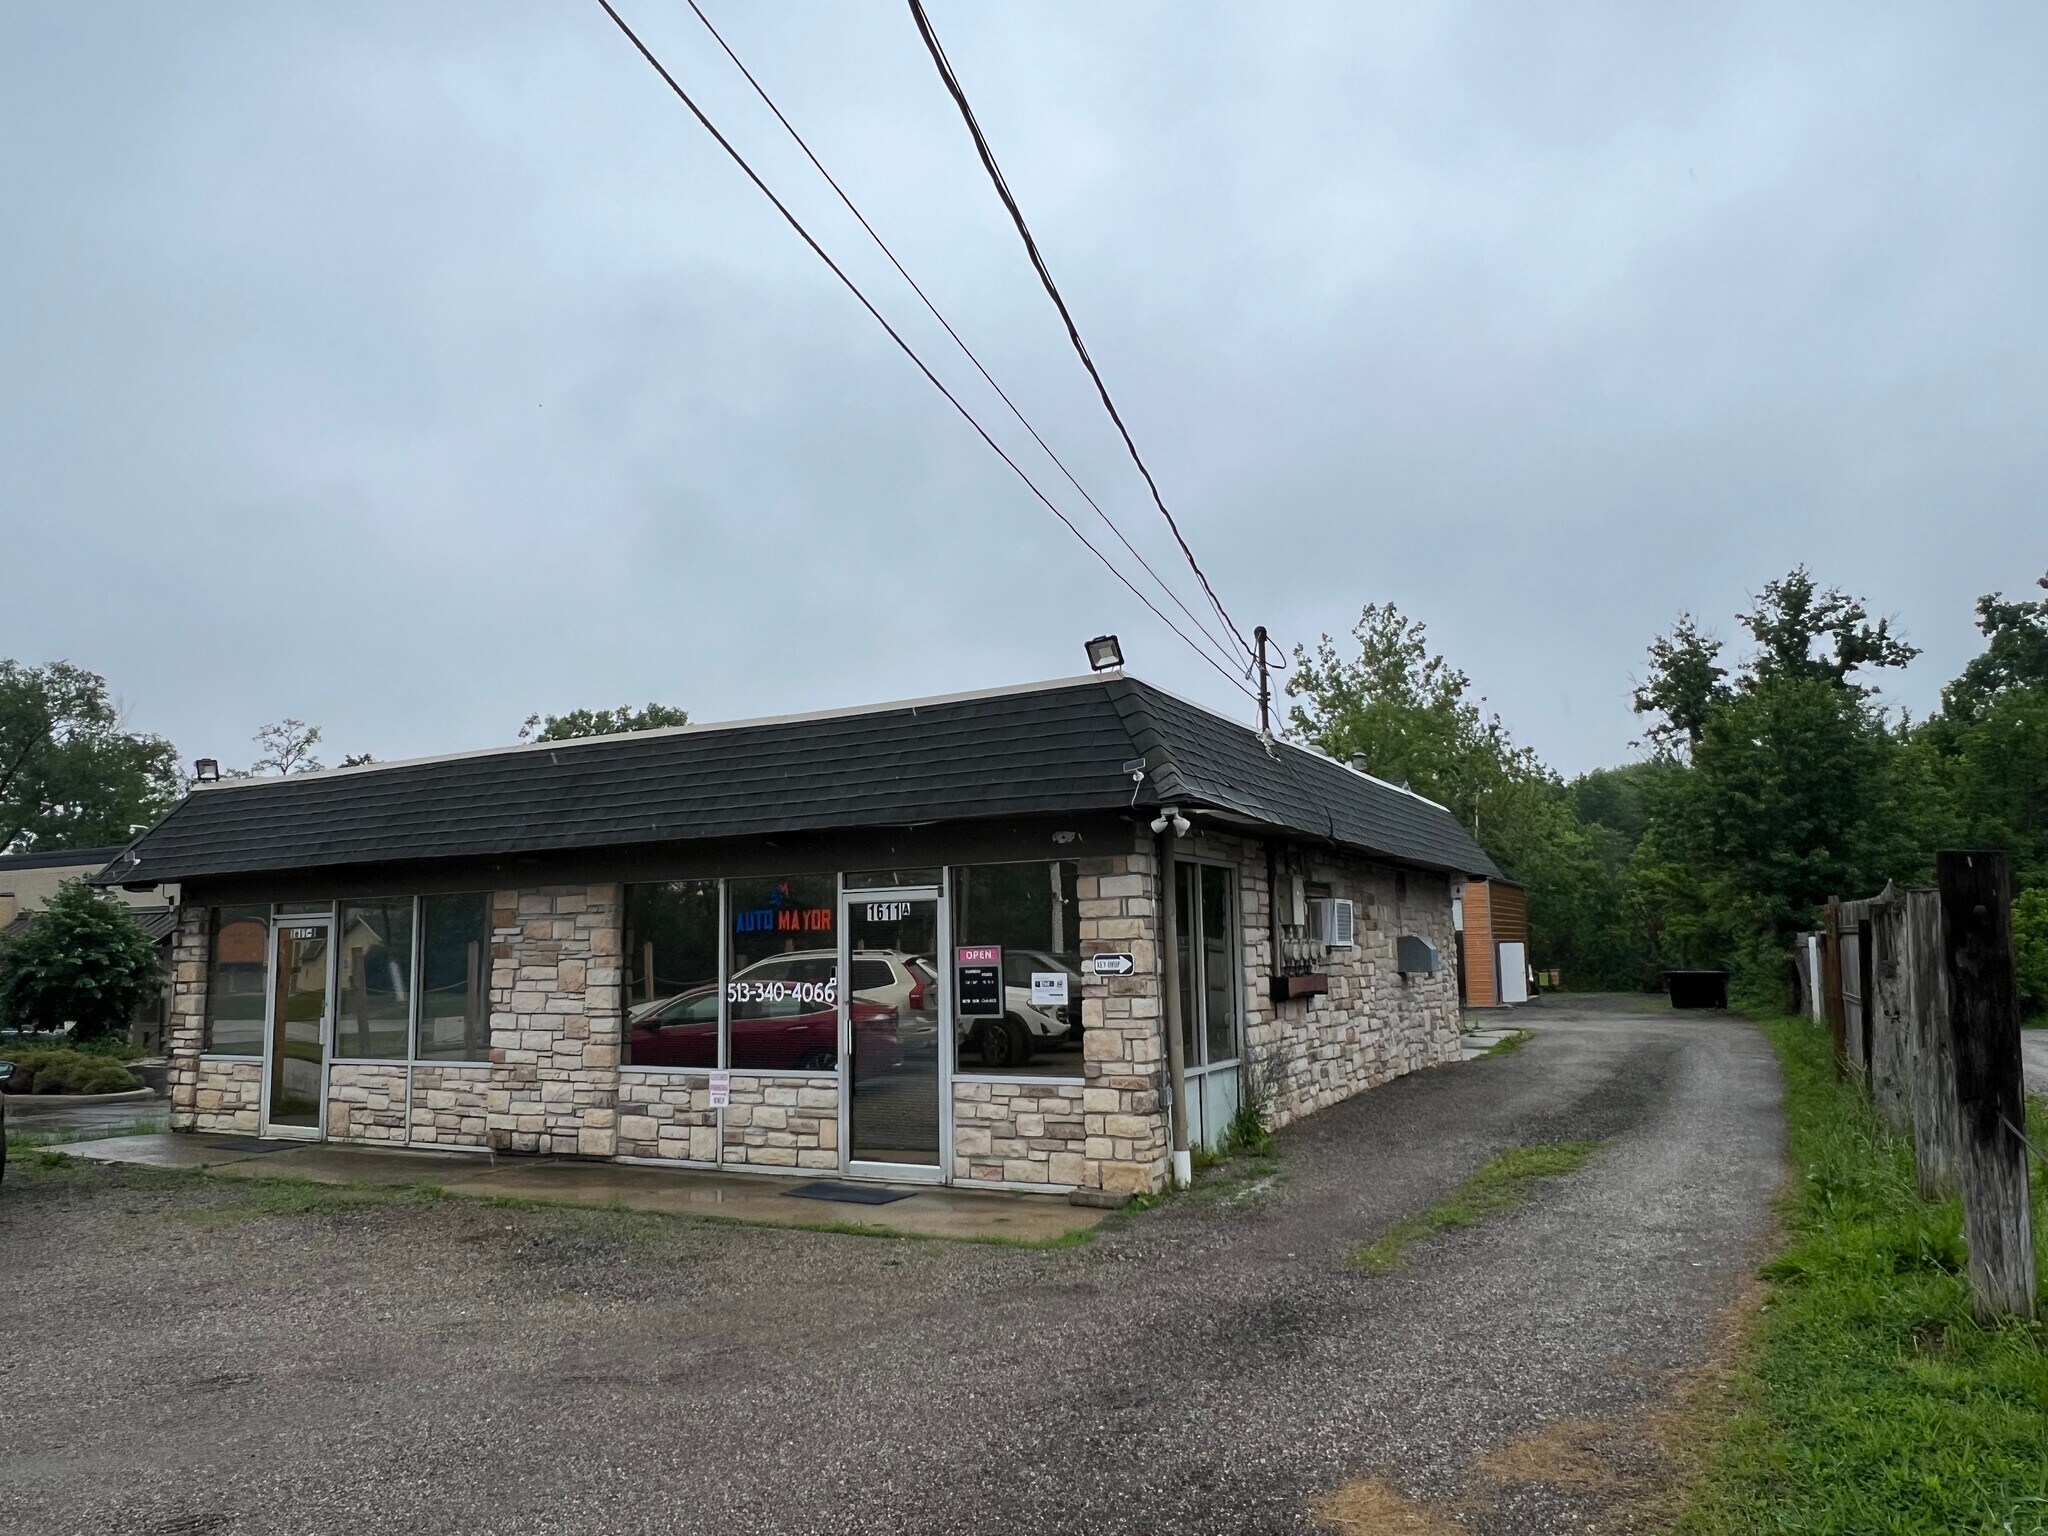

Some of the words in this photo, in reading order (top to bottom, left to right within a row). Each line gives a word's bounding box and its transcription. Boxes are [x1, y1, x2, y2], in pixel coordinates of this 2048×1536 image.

[736, 909, 774, 933] AUTO
[778, 909, 832, 931] MAYOR
[965, 950, 992, 960] OPEN
[728, 979, 837, 1003] 513-340-4066
